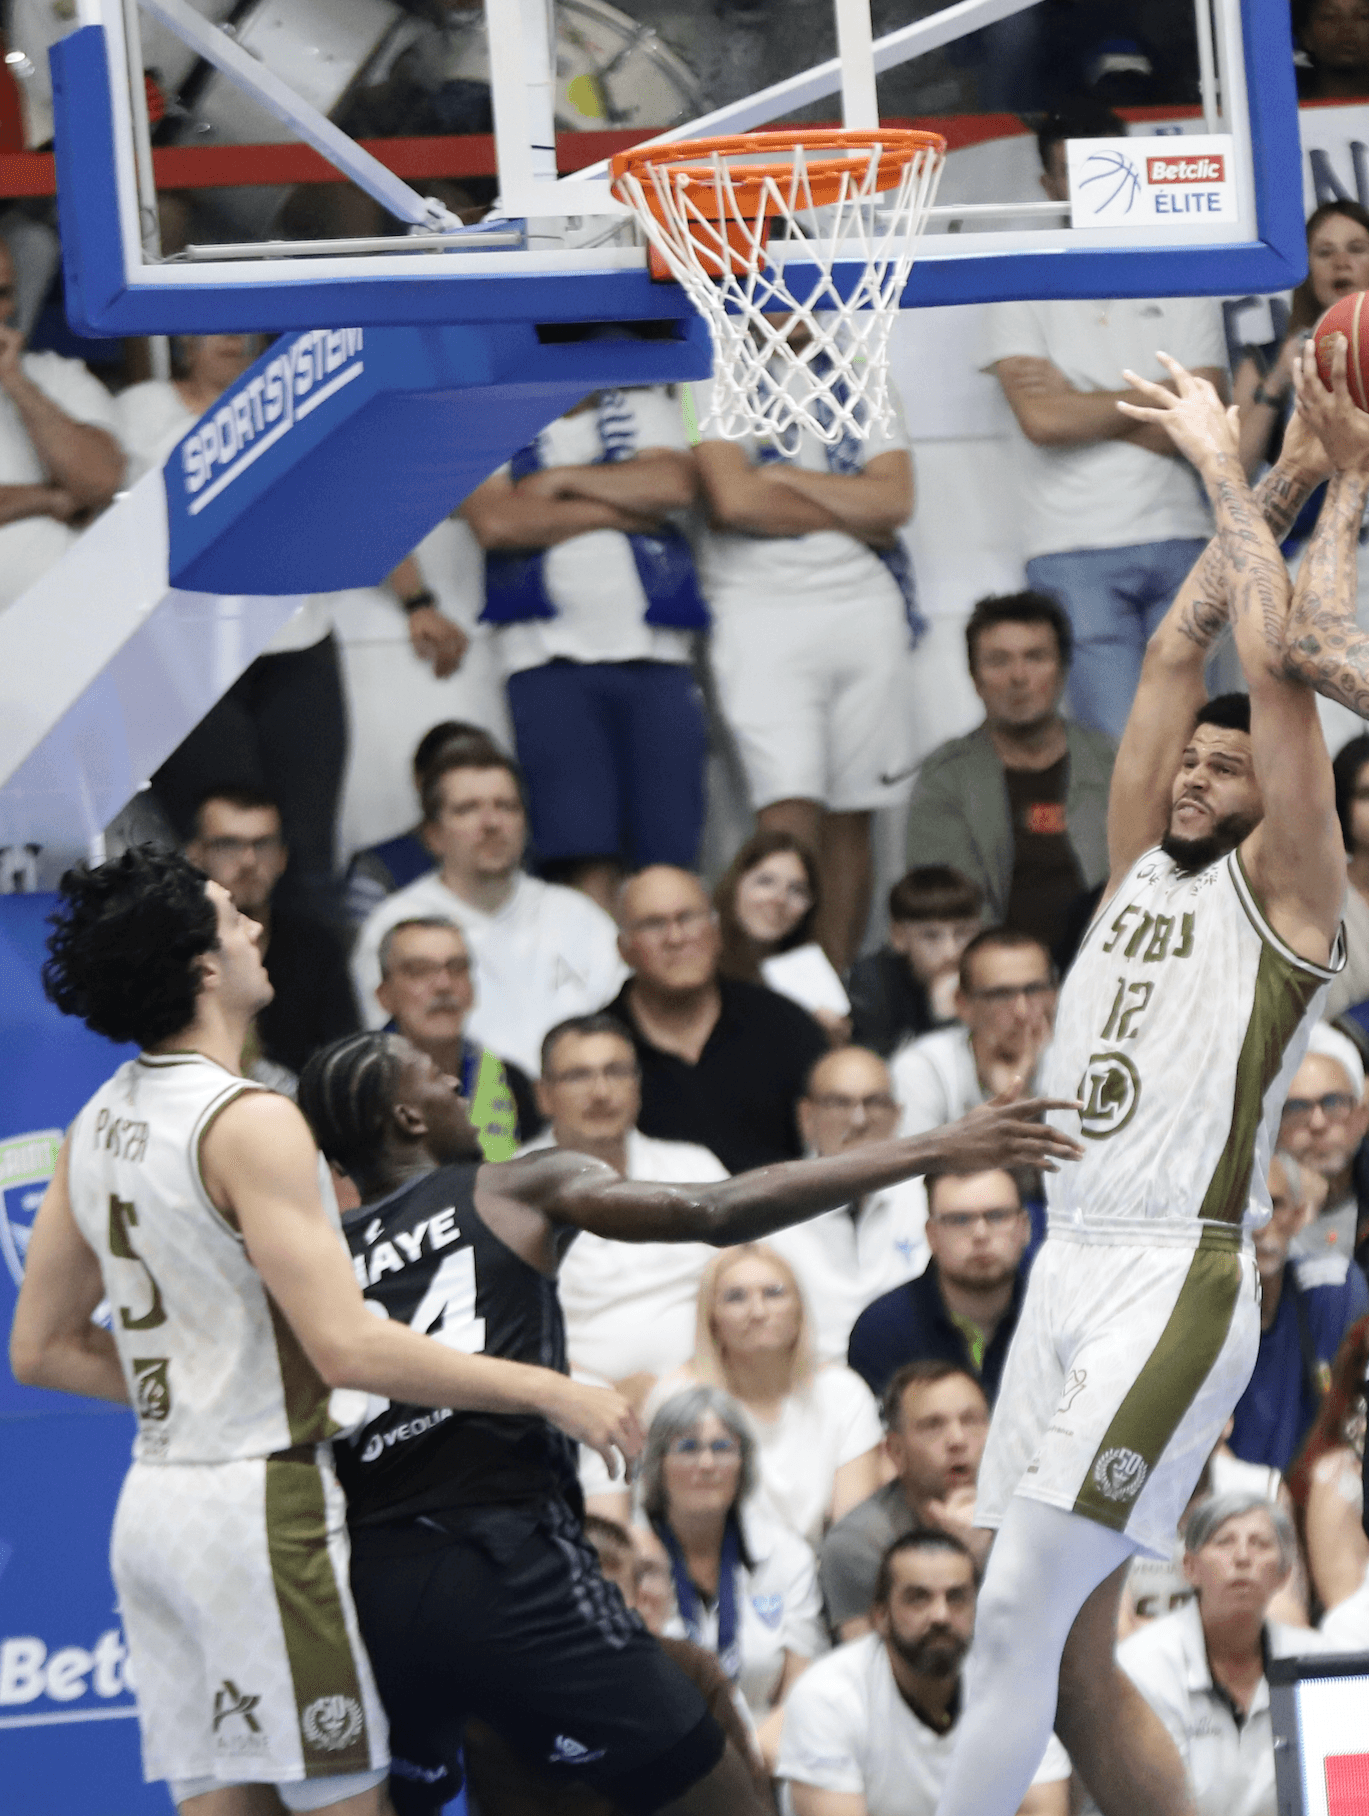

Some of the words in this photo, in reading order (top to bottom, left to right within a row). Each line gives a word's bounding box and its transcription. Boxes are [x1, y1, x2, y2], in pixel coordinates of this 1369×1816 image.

[1151, 158, 1221, 181] Betclic
[1154, 189, 1222, 214] ÉLITE
[1100, 976, 1156, 1042] 12
[108, 1192, 168, 1330] 5
[383, 1407, 453, 1447] VEOLIA
[1115, 1447, 1143, 1475] 50
[0, 1629, 138, 1704] Bet
